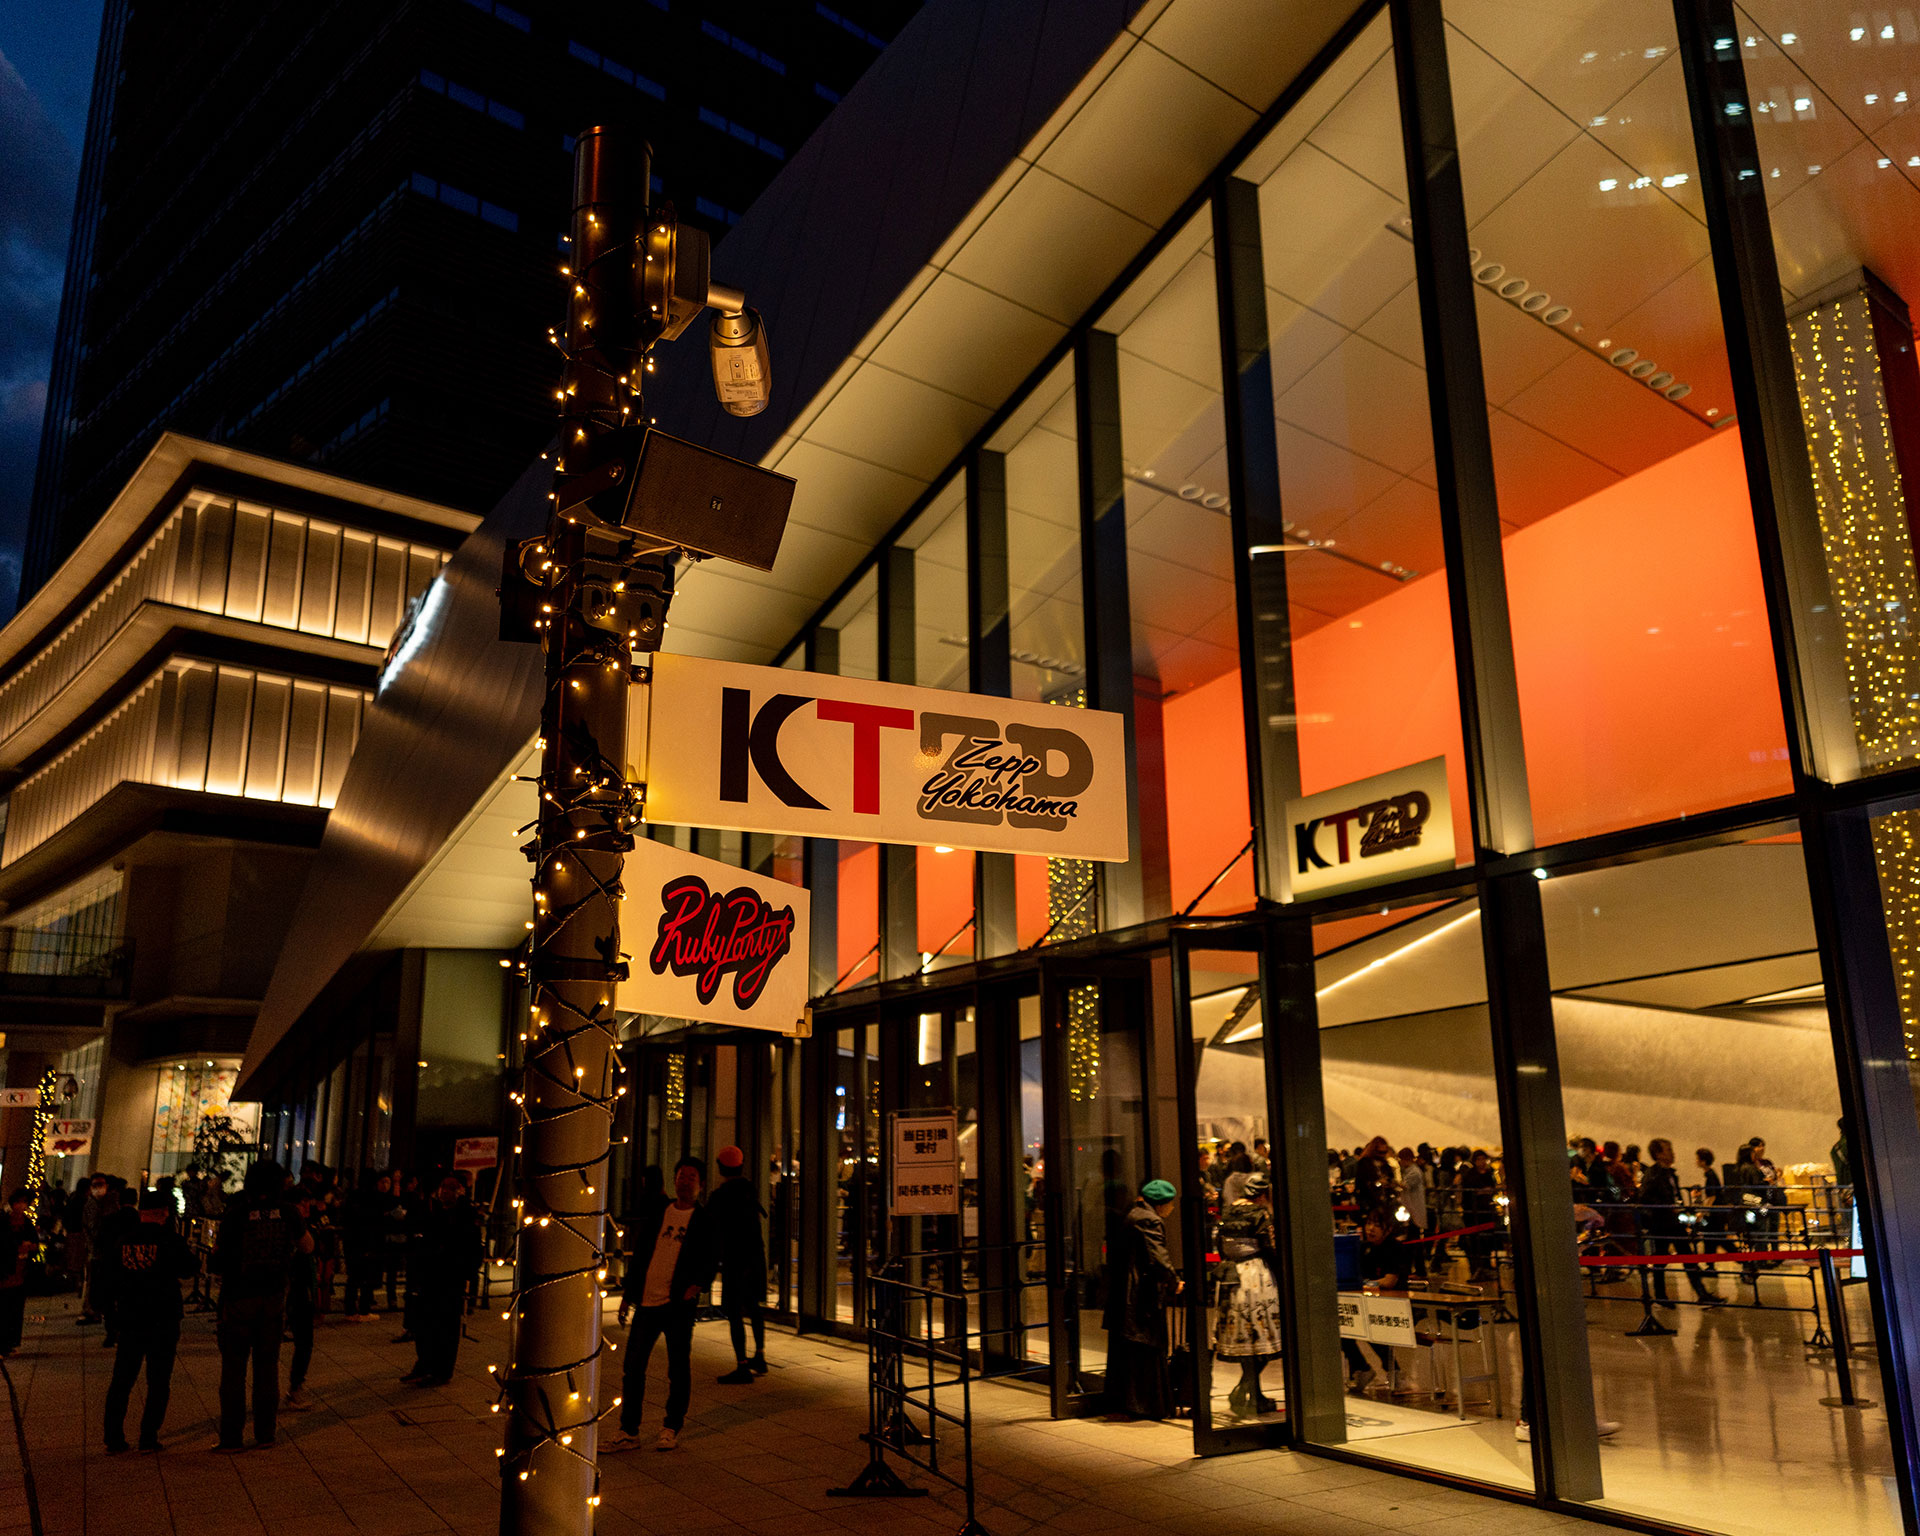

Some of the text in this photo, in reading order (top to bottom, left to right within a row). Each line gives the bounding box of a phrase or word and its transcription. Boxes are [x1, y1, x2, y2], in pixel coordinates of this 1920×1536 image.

[955, 738, 1039, 784] Zepp
[922, 772, 1077, 817] Yokohama
[903, 1128, 948, 1142] 当日引換
[915, 1142, 937, 1154] 受付
[897, 1184, 954, 1197] 関係者受付
[1368, 1313, 1410, 1329] 関係者受付
